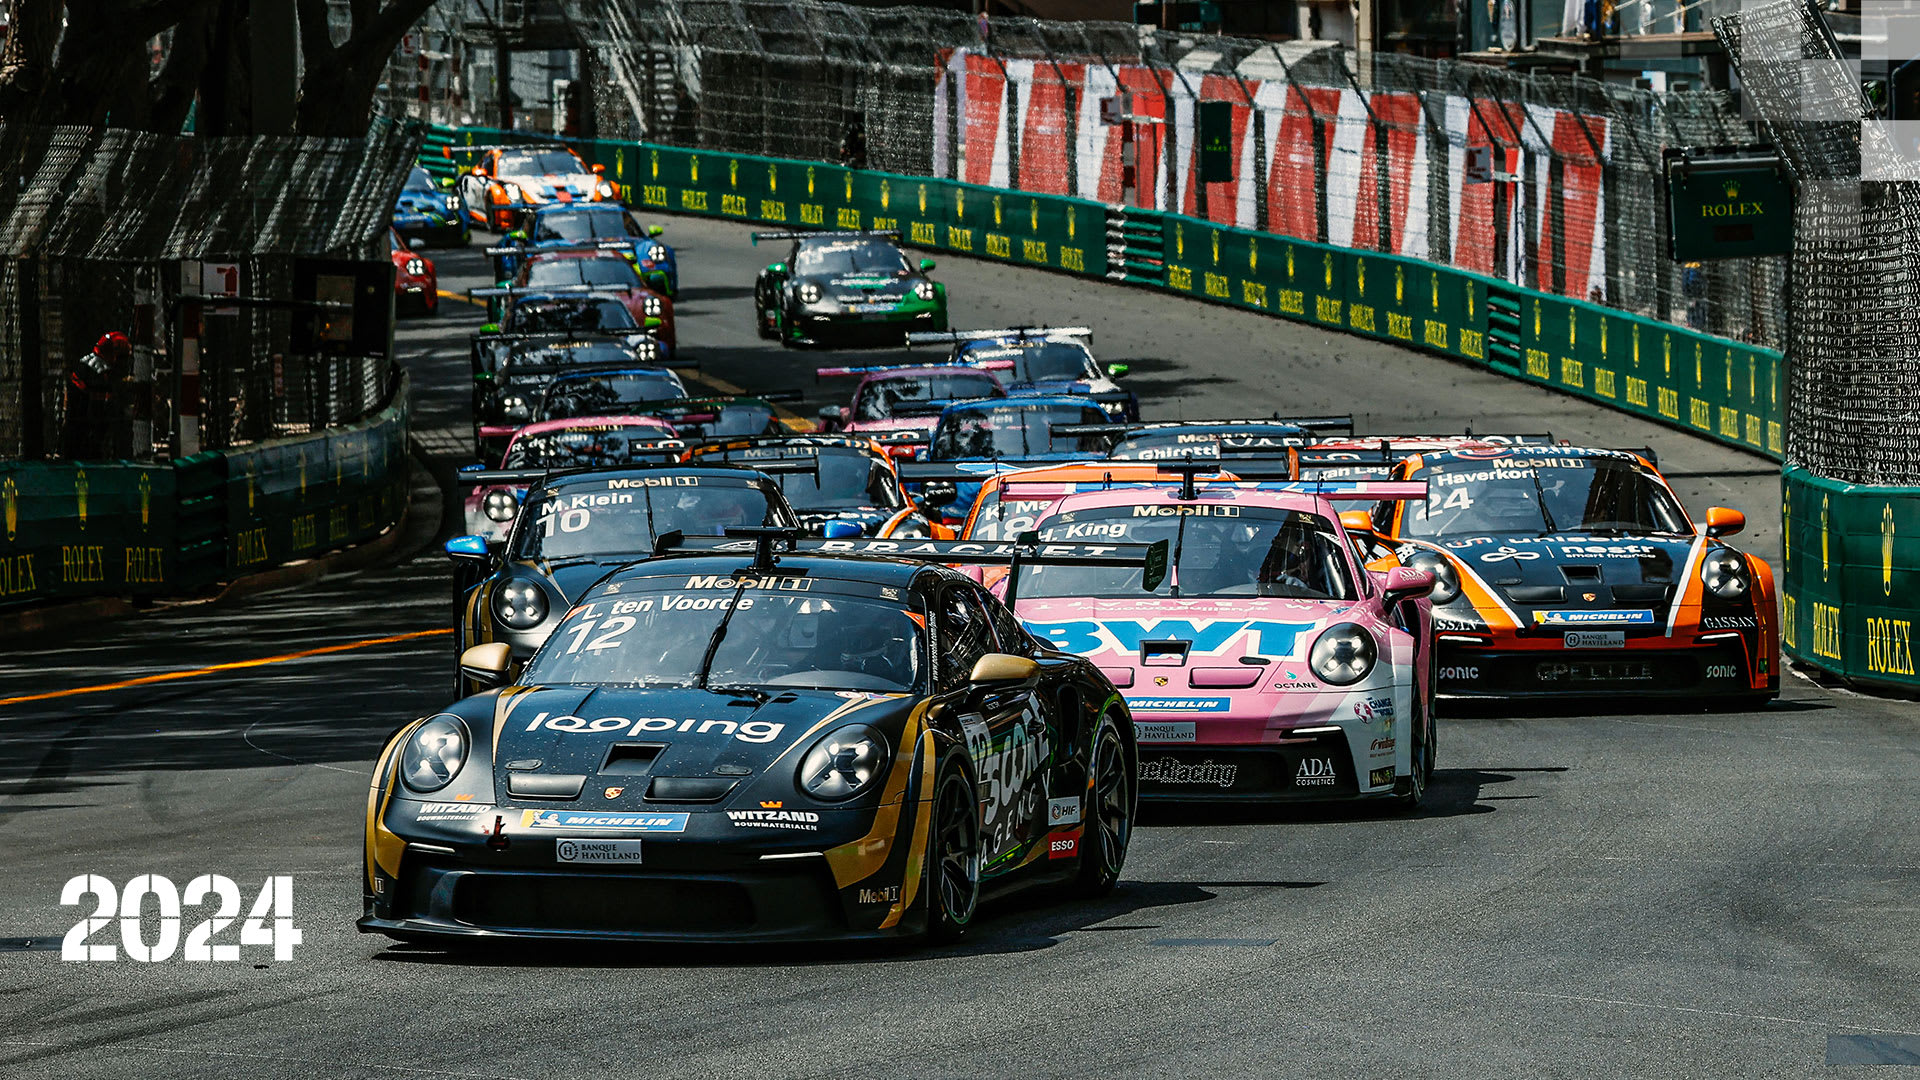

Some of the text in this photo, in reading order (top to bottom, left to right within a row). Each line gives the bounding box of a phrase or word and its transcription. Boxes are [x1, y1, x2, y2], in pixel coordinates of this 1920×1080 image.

[1702, 202, 1764, 217] ROLEX
[1492, 458, 1557, 469] Mobil
[607, 478, 673, 489] Mobil
[1438, 468, 1538, 487] Haverkort
[1132, 505, 1209, 517] Mobil
[536, 507, 591, 538] 10
[976, 516, 1035, 541] 18
[1065, 522, 1128, 539] King
[236, 527, 269, 567] ROLEX
[62, 545, 104, 582] ROLEX
[125, 546, 164, 582] ROLEX
[685, 575, 776, 589] Mobil
[581, 603, 603, 621] L.
[612, 598, 654, 615] ten
[1434, 619, 1479, 630] SSAN
[1704, 616, 1756, 629] GASSAN
[566, 615, 637, 656] 12
[1813, 602, 1841, 660] ROLEX
[1024, 618, 1328, 663] BWT
[1867, 617, 1915, 676] ROLEX
[1128, 700, 1219, 709] MICHELIN
[525, 711, 786, 743] looping
[1297, 758, 1336, 777] ADA
[419, 803, 492, 814] WITZAND
[726, 810, 819, 823] WITZAND
[566, 816, 674, 827] MICHELIN
[734, 821, 817, 831] BOUWMATERIALEN
[581, 843, 617, 851] BANQUE
[1051, 840, 1075, 851] ESSO
[581, 850, 641, 860] HAVILLAND
[858, 887, 890, 904] Mobil
